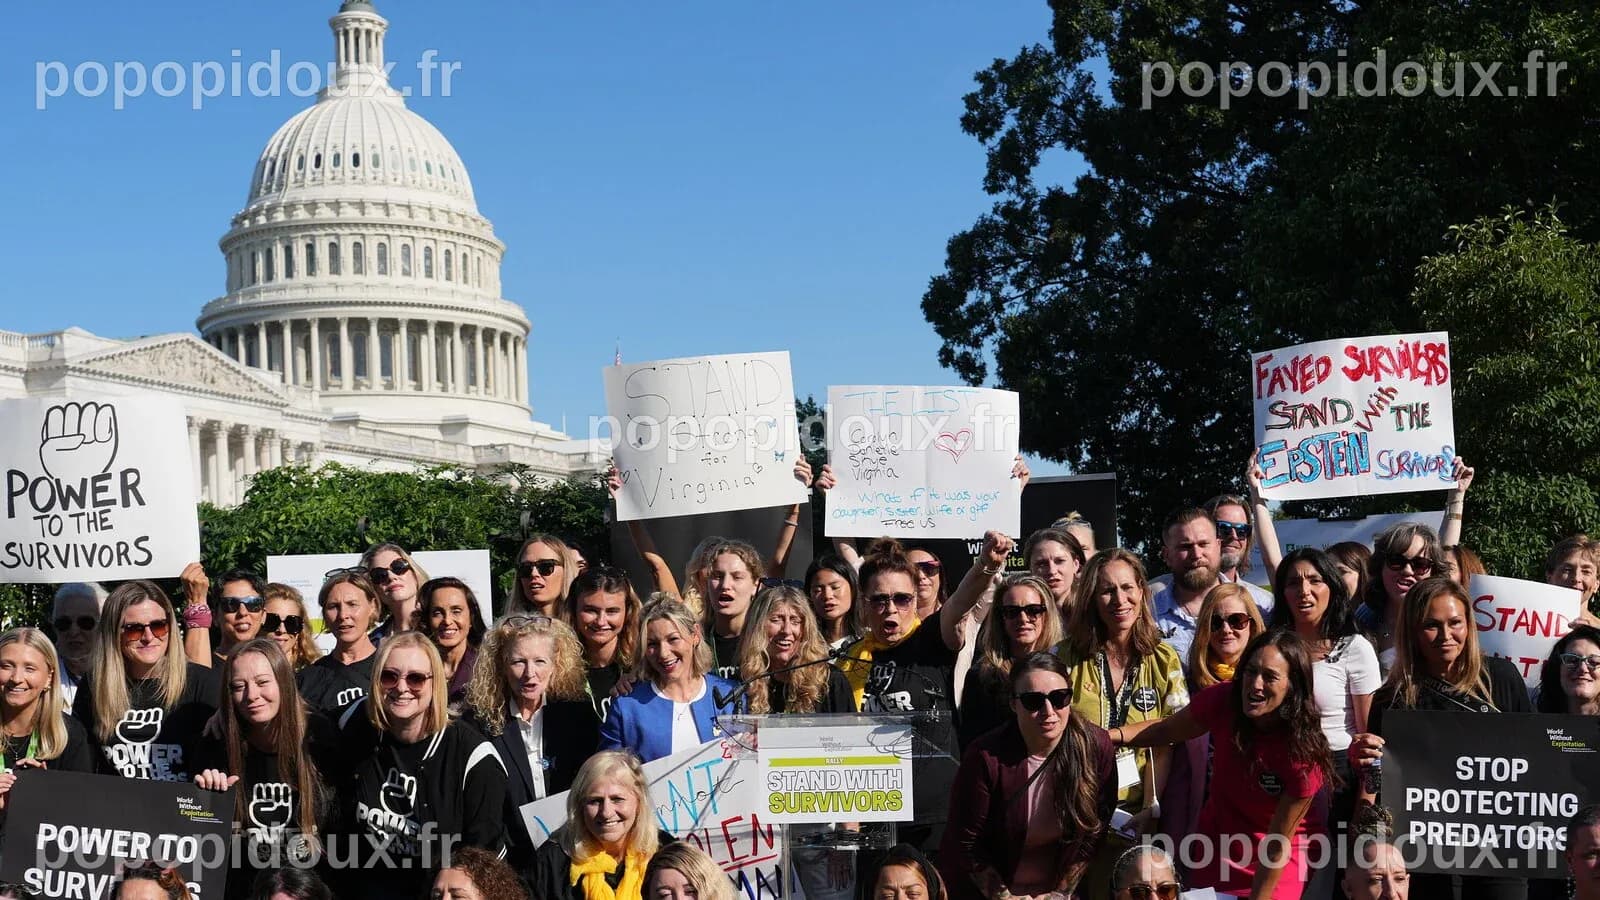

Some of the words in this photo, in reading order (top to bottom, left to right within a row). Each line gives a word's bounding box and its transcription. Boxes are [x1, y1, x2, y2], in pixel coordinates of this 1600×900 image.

[624, 360, 782, 426] STAND
[1256, 353, 1332, 399] FAYED
[1265, 397, 1354, 431] STAND
[1390, 402, 1432, 431] THE
[7, 468, 146, 519] POWER
[634, 467, 755, 508] Virginia
[33, 514, 63, 538] TO
[69, 509, 113, 535] THE
[0, 536, 153, 570] SURVIVORS
[1472, 594, 1570, 638] STAND
[767, 769, 841, 791] STAND
[845, 769, 903, 790] WITH
[1456, 756, 1529, 782] STOP
[768, 790, 904, 814] SURVIVORS
[1406, 787, 1579, 818] PROTECTING
[36, 823, 152, 859] POWER
[158, 834, 199, 863] TO
[1409, 821, 1568, 851] PREDATORS
